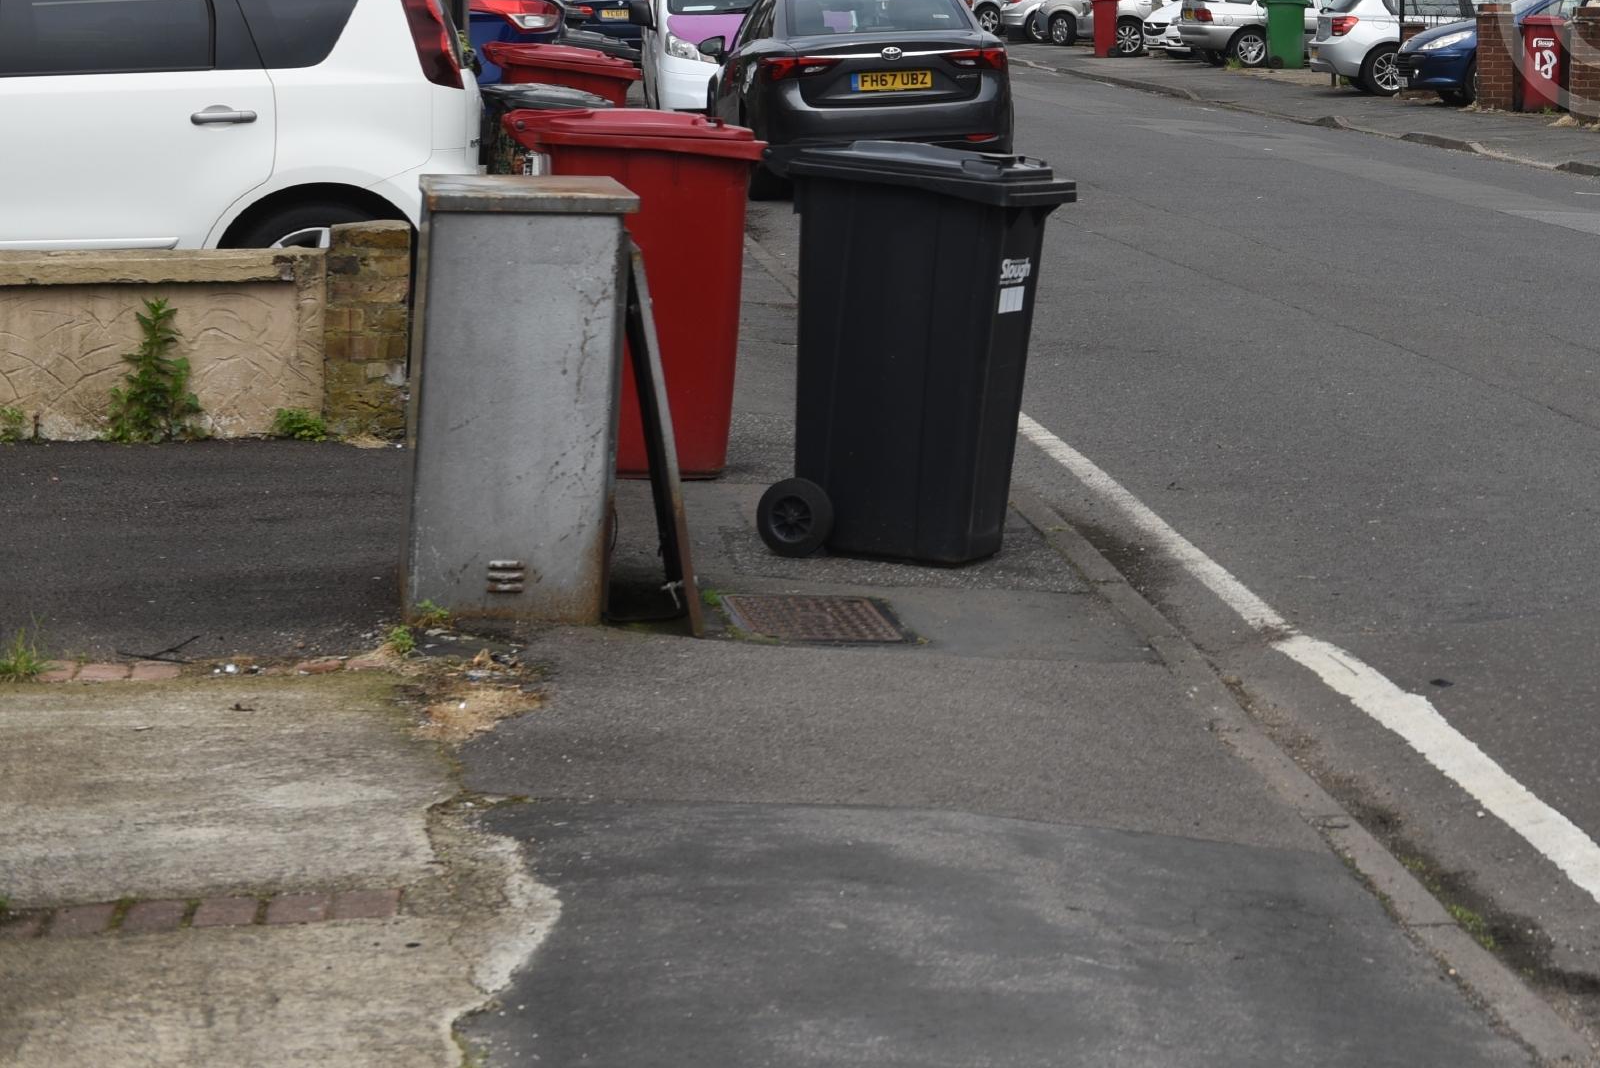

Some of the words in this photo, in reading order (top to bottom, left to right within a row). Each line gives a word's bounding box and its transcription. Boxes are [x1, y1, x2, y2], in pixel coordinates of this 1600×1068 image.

[1534, 49, 1557, 79] 18
[861, 73, 898, 87] FH67
[901, 72, 928, 85] UBZ
[1000, 257, 1031, 282] Slough
